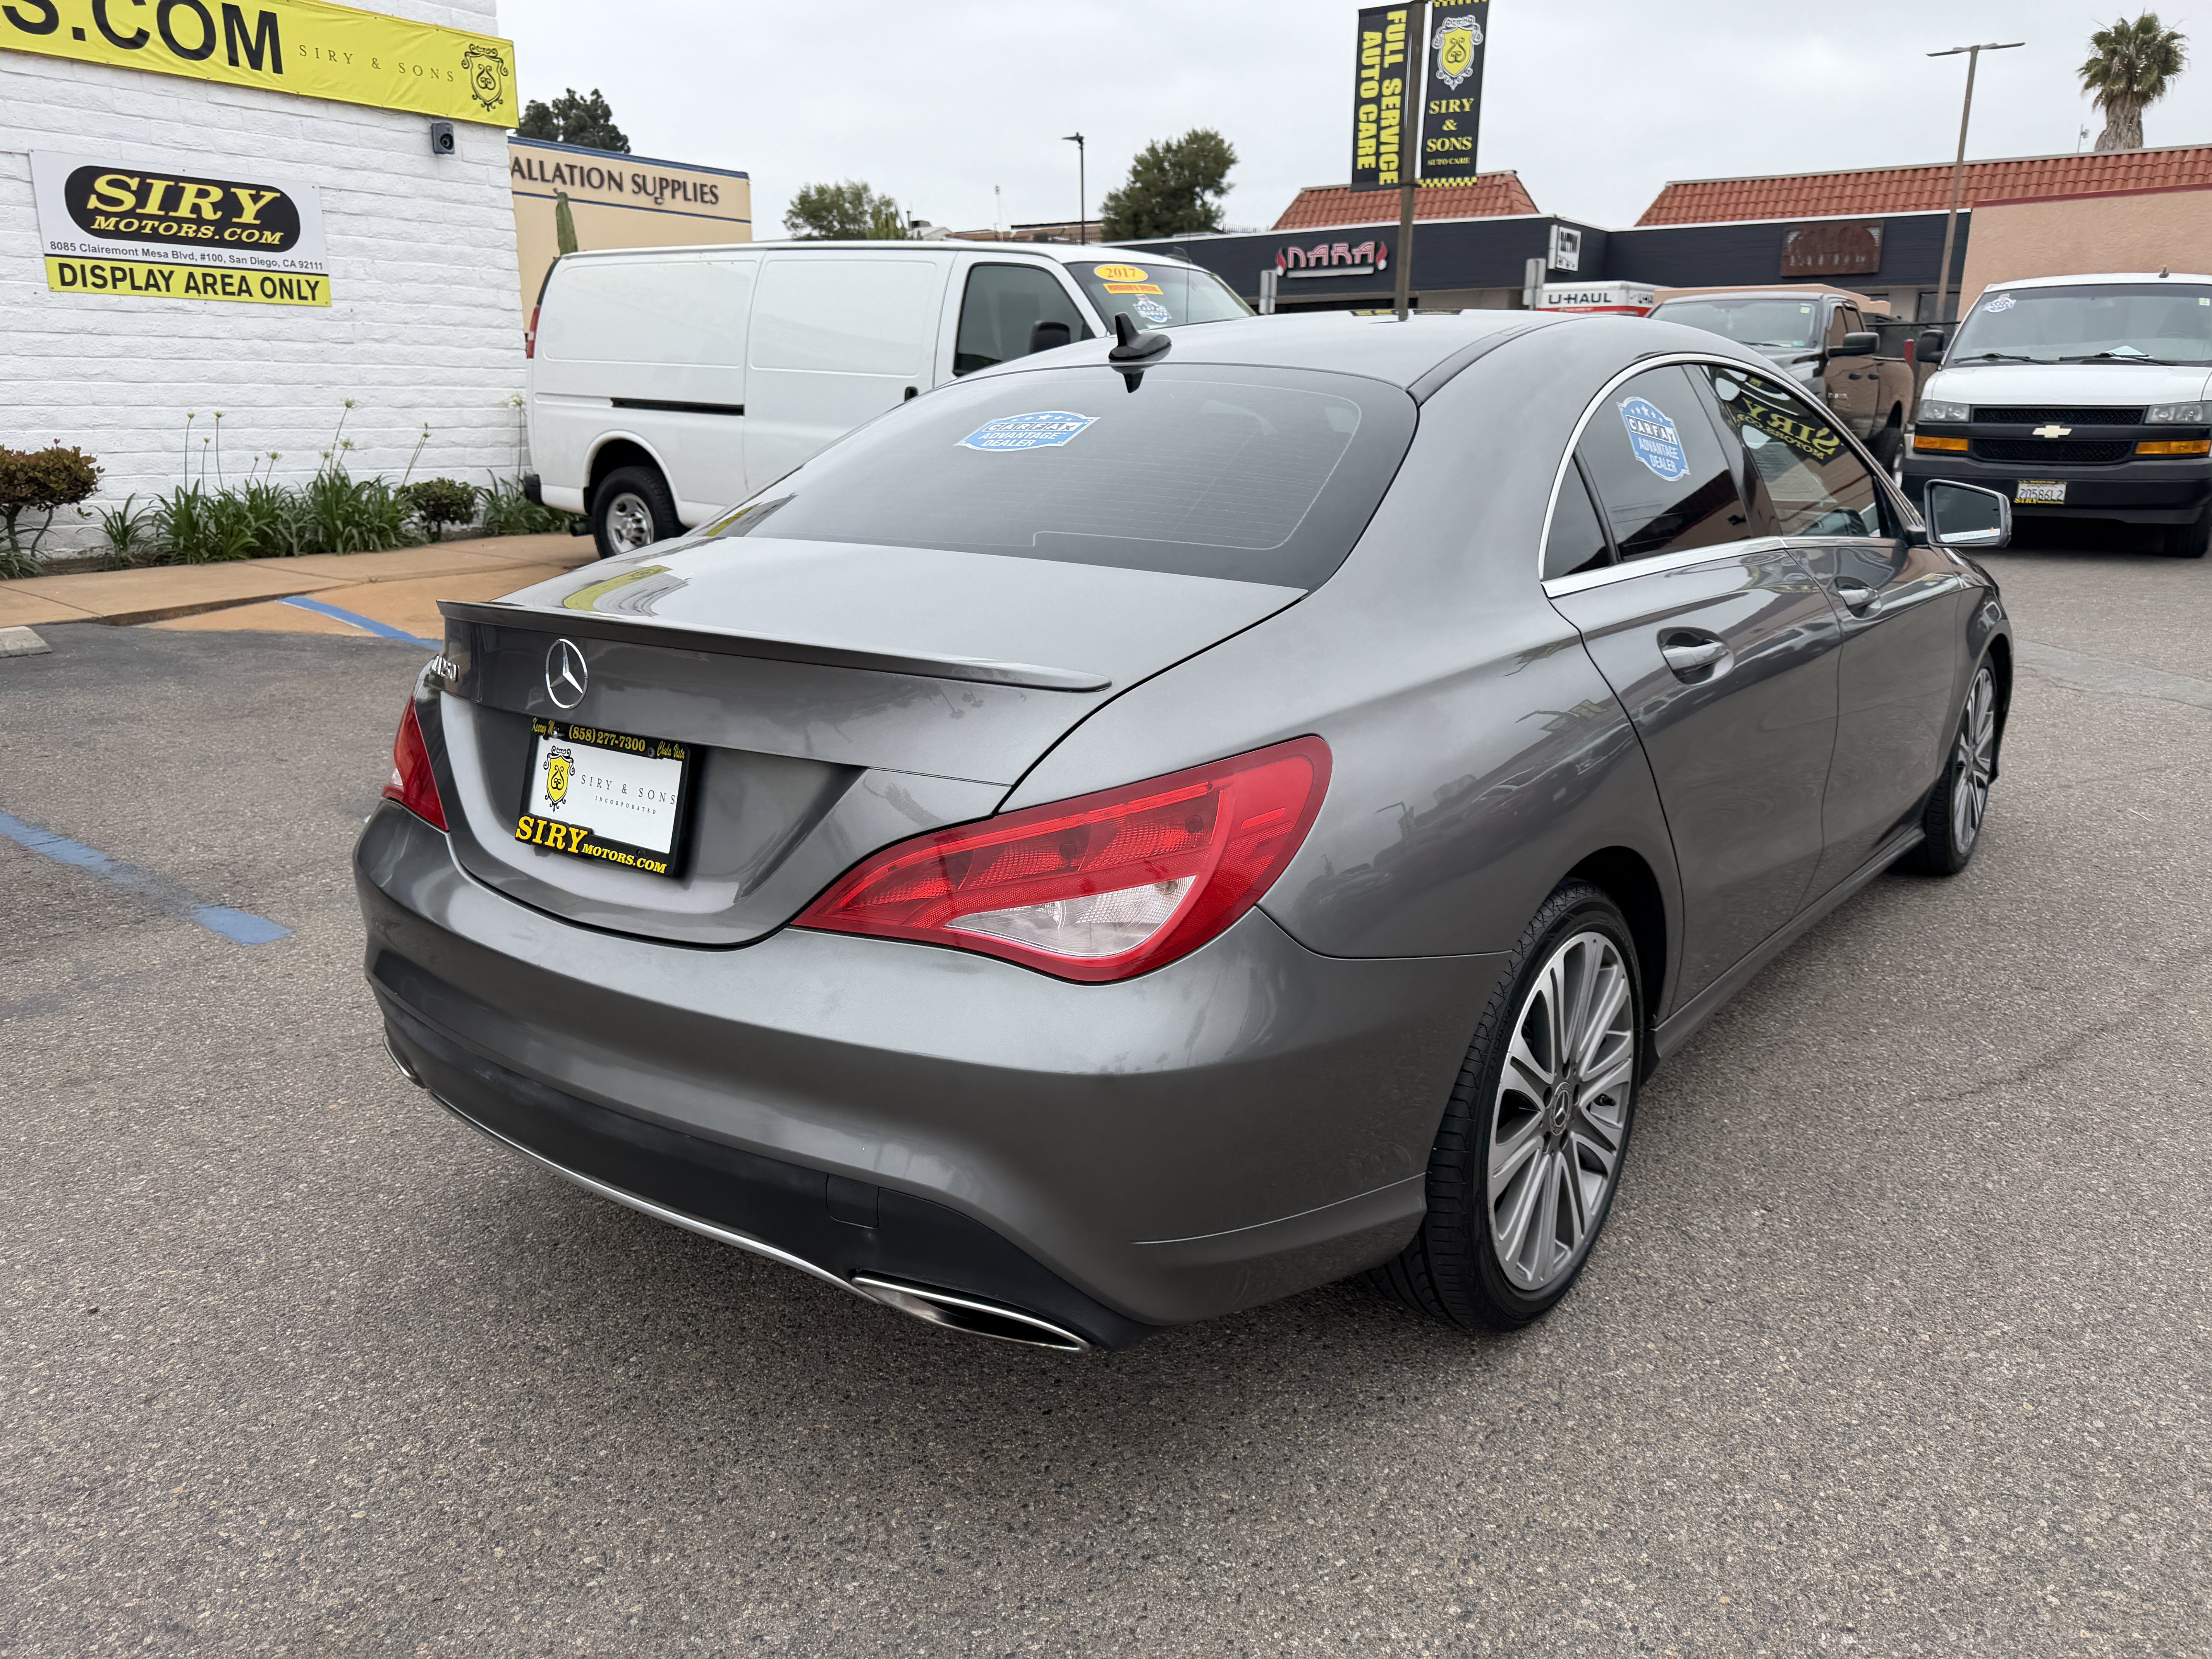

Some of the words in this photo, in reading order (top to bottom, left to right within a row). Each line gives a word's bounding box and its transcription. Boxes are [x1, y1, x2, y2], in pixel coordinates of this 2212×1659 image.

[1384, 10, 1407, 68] FULL
[299, 45, 353, 64] SIRY
[371, 58, 381, 70] &
[398, 62, 454, 82] SONS
[1359, 31, 1382, 98] AUTO
[1429, 98, 1475, 114] SIRY
[1357, 104, 1378, 170] CARE
[1379, 78, 1402, 185] SERVICE
[1442, 119, 1457, 131] &
[1426, 137, 1472, 153] SONS
[512, 156, 624, 193] ALLATION
[632, 173, 720, 205] SUPPLIES
[87, 174, 281, 224] SIRY
[90, 216, 284, 244] MOTORS.COM
[50, 241, 76, 251] 8085
[79, 244, 139, 256] Clairemont
[141, 248, 168, 258] Mesa
[172, 251, 198, 261] Blvd,
[200, 253, 226, 264] #100,
[228, 255, 247, 264] San
[250, 257, 280, 268] Diego,
[282, 259, 299, 268] CA
[299, 261, 323, 270] 92111
[1287, 241, 1375, 268] NARA
[58, 263, 175, 292] DISPLAY
[184, 272, 254, 297] AREA
[260, 276, 320, 301] ONLY
[1106, 268, 1136, 278] 2017
[1549, 293, 1613, 304] U-HAUL
[986, 422, 1079, 431] CARFAX
[1628, 418, 1678, 445] CARFAX
[1638, 437, 1680, 460] ADVANTAGE
[1649, 454, 1678, 473] DEALER
[568, 725, 596, 744] (858)
[597, 731, 646, 752] 277-7300
[581, 775, 612, 790] SIRY
[622, 784, 627, 794] &
[638, 788, 675, 805] SONS
[595, 796, 656, 814] INCORPORATED
[515, 816, 588, 854] SIRY
[581, 843, 667, 874] MOTORS.COM
